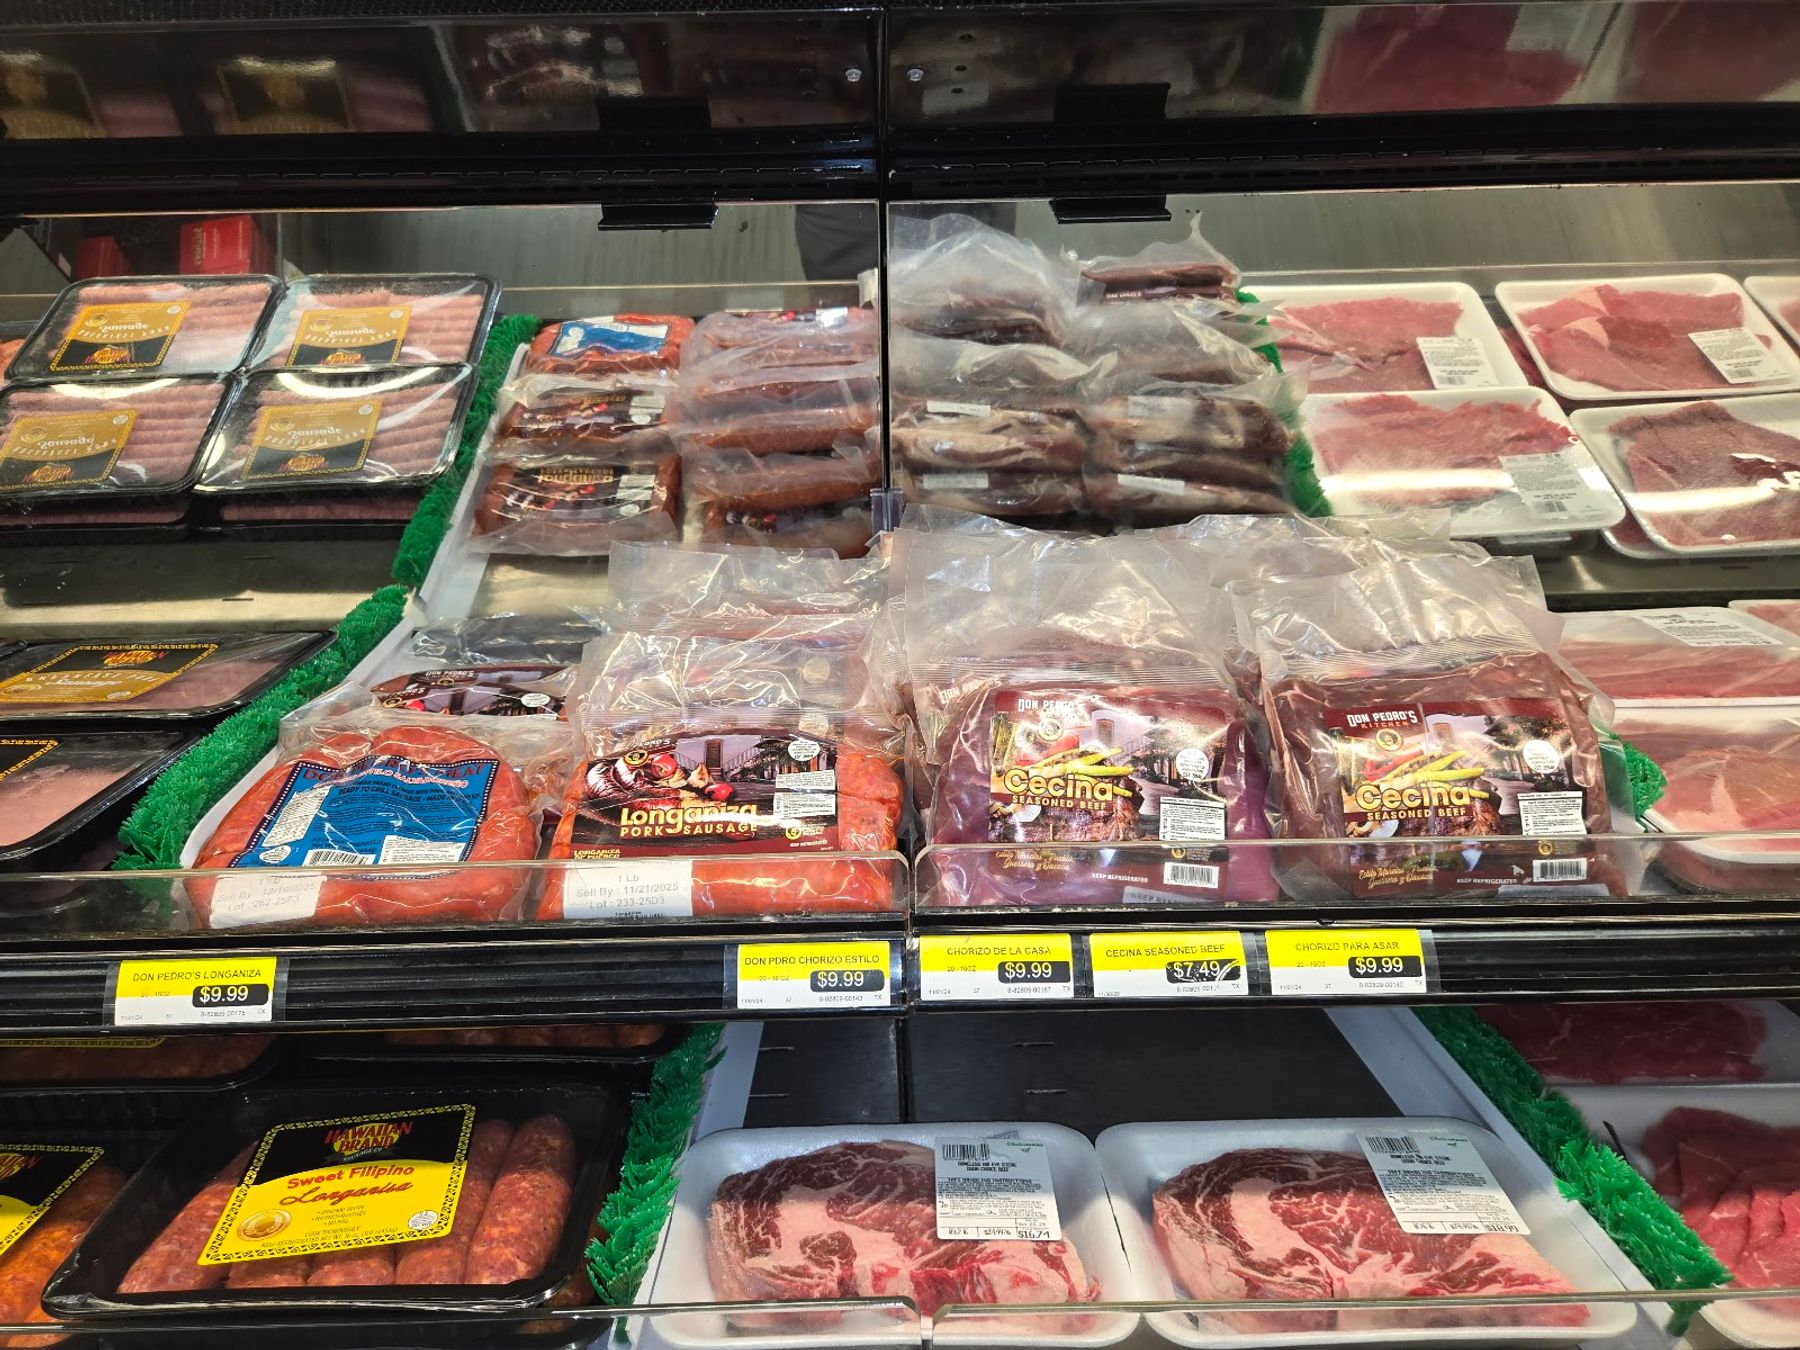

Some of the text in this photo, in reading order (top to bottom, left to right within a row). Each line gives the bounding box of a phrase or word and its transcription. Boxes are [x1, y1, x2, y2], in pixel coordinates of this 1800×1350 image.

[1017, 698, 1038, 712] DON
[1346, 710, 1418, 726] DON PEDRO'S
[1360, 720, 1410, 730] KITCHEN
[1003, 766, 1114, 802] Cecina
[1012, 794, 1107, 812] SEASONED BEEF
[1354, 783, 1471, 811] Cecina
[619, 802, 758, 834] Longaniza
[1366, 808, 1466, 822] SEASONED BEEF
[620, 824, 758, 838] PORK SAUSAGE
[573, 848, 621, 856] LONGANIZA
[576, 887, 596, 898] Sell
[623, 882, 680, 895] 11/21/2025
[947, 946, 1051, 956] CHORIZO DE LA CASA
[1105, 944, 1225, 958] CECINA SEASONED BEEF
[1295, 941, 1400, 951] CHORIZO PARA ASAR
[744, 957, 766, 966] DON
[798, 956, 843, 965] CHORIZO
[845, 955, 880, 964] ESTILO
[1355, 957, 1404, 975] $9.99
[132, 969, 262, 982] DON PEDRO'S LONGANIZA
[1004, 962, 1052, 980] $9.99
[1173, 961, 1220, 978] $7.49
[816, 971, 865, 989] $9.99
[199, 985, 249, 1004] $9.99
[324, 1120, 413, 1144] HAWAIIAN
[339, 1136, 396, 1153] BRAND
[286, 1164, 416, 1190] Sweet Filipino
